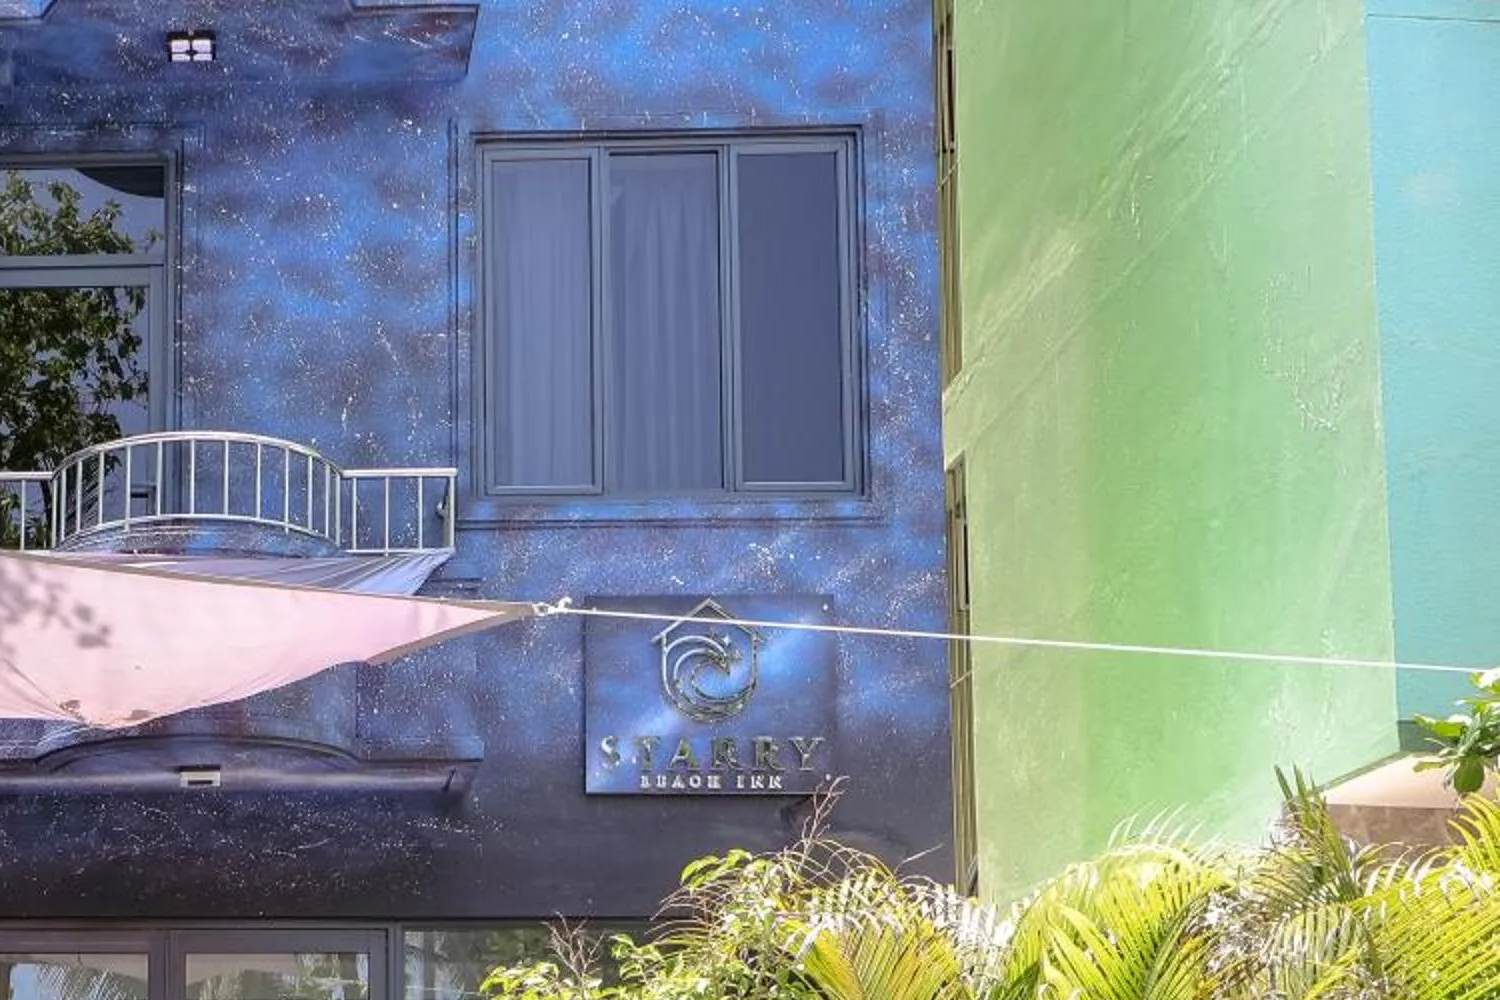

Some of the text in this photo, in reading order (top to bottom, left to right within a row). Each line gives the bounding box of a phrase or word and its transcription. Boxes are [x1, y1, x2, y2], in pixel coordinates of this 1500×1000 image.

[600, 735, 825, 770] STARRY
[639, 774, 784, 790] BEACH INN
